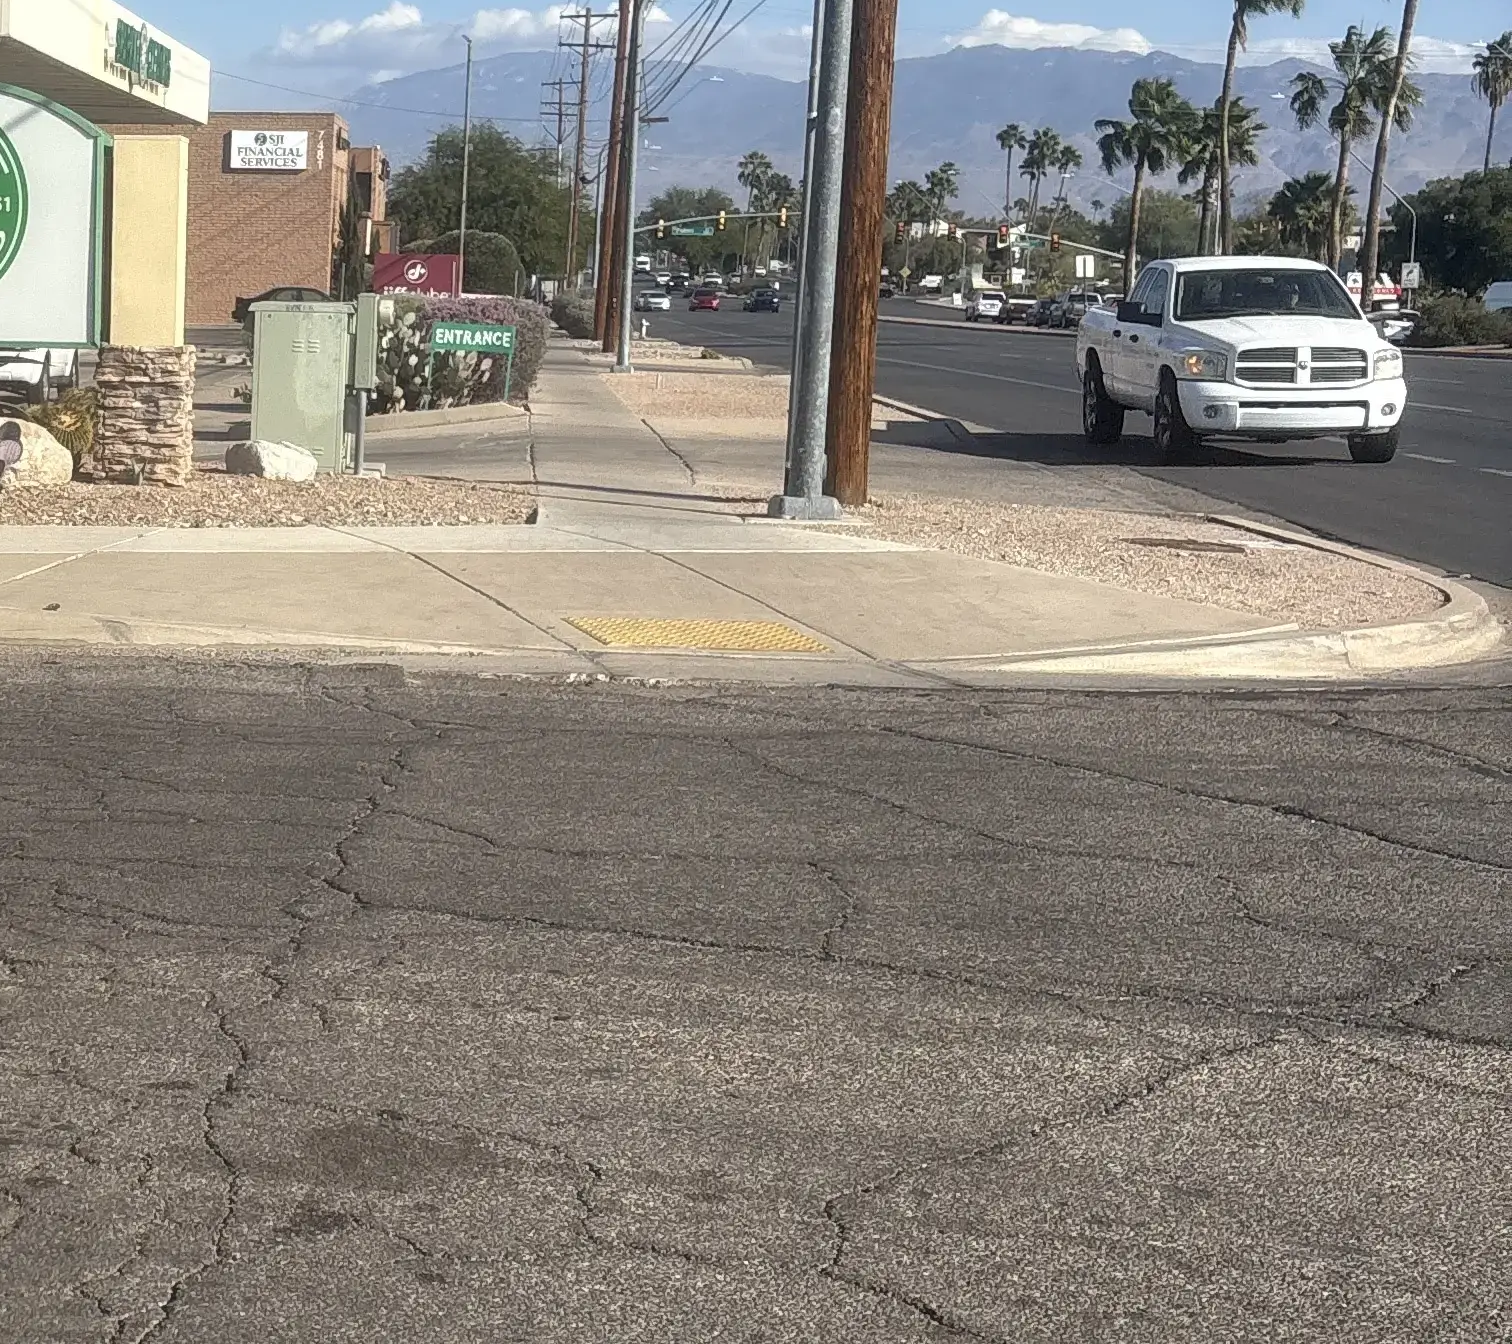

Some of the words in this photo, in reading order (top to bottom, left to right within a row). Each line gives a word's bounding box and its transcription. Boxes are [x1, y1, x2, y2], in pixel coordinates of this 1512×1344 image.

[268, 134, 285, 146] SJI
[237, 146, 304, 158] FINANCIAL
[240, 157, 298, 168] SERVICES
[435, 328, 512, 348] ENTRANCE
